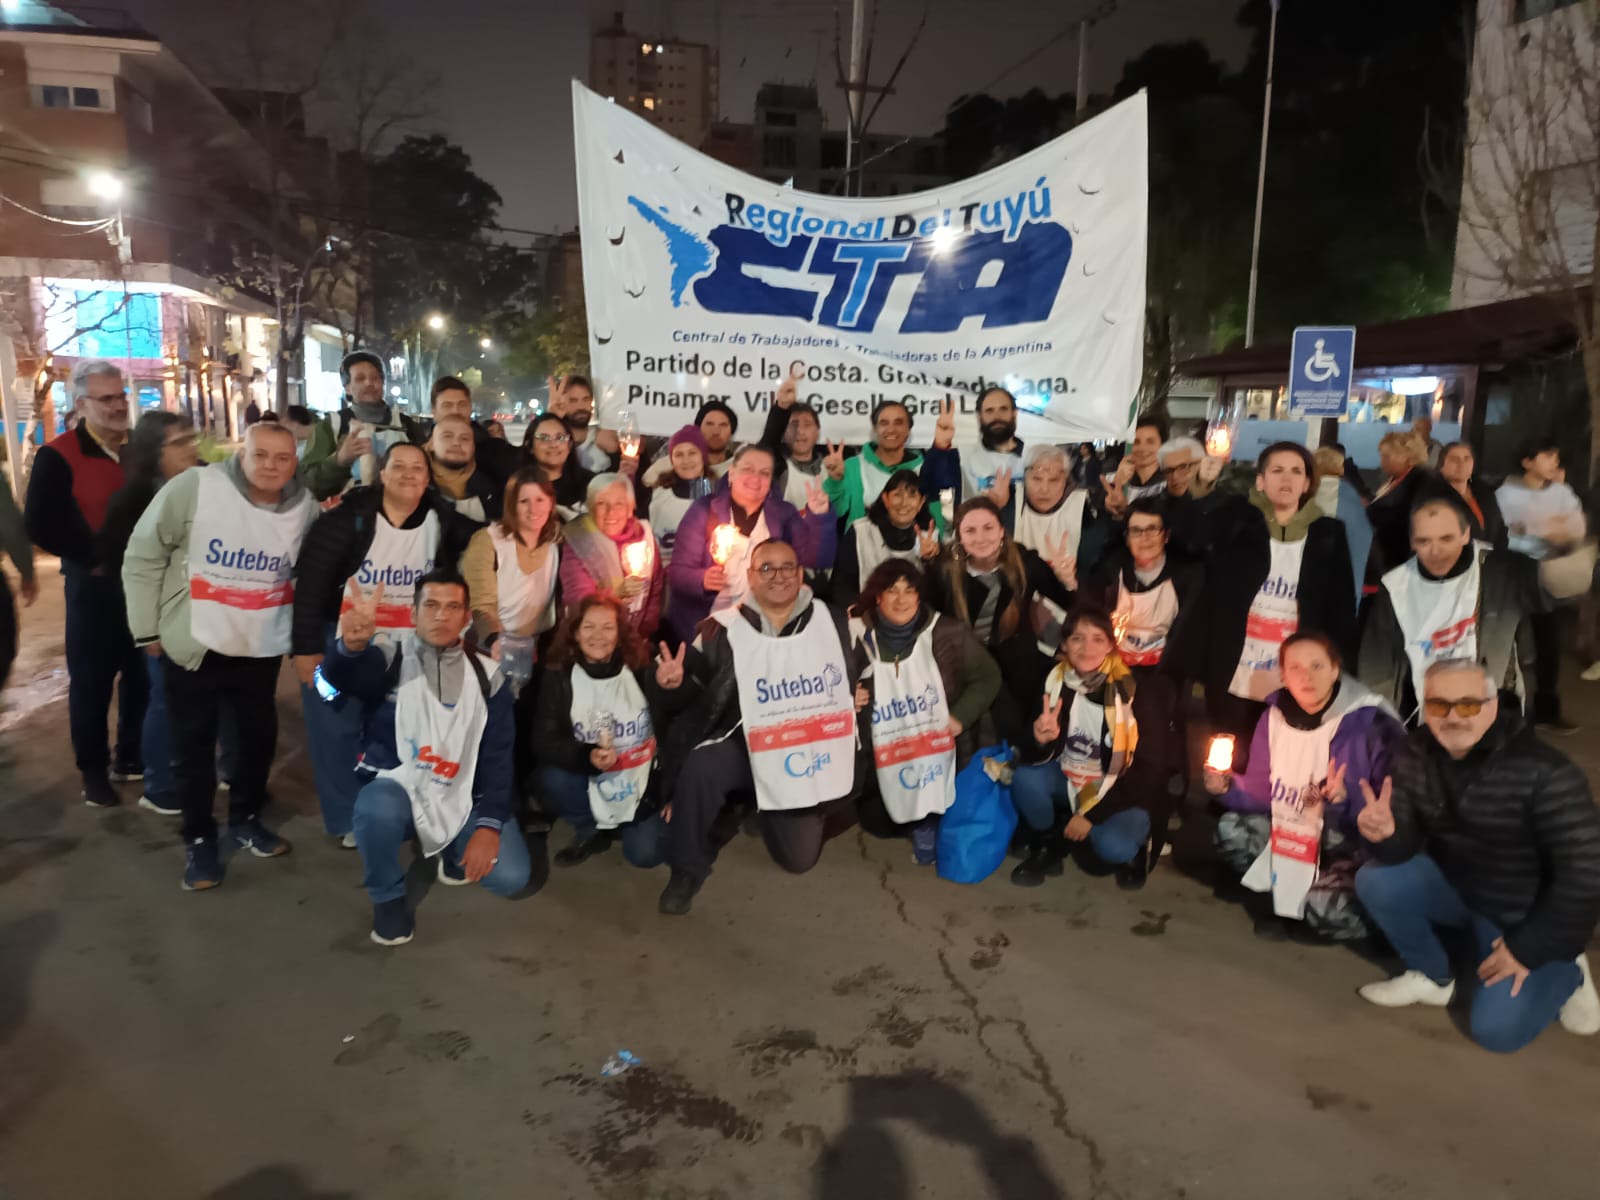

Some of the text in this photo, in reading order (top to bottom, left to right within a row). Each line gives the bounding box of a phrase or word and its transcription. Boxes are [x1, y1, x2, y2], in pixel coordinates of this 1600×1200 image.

[726, 176, 1053, 243] Regional Del Tuyú
[693, 221, 1074, 334] CTA
[672, 330, 725, 344] Central
[729, 332, 746, 344] de
[751, 333, 839, 349] Trabajadores
[943, 349, 961, 361] de
[965, 348, 977, 359] la
[982, 341, 1053, 360] Argentina
[626, 350, 716, 377] Partido
[723, 355, 753, 379] de
[761, 357, 781, 380] la
[789, 360, 868, 383] Costa.
[205, 538, 282, 572] Suteba
[756, 674, 825, 704] Suteba
